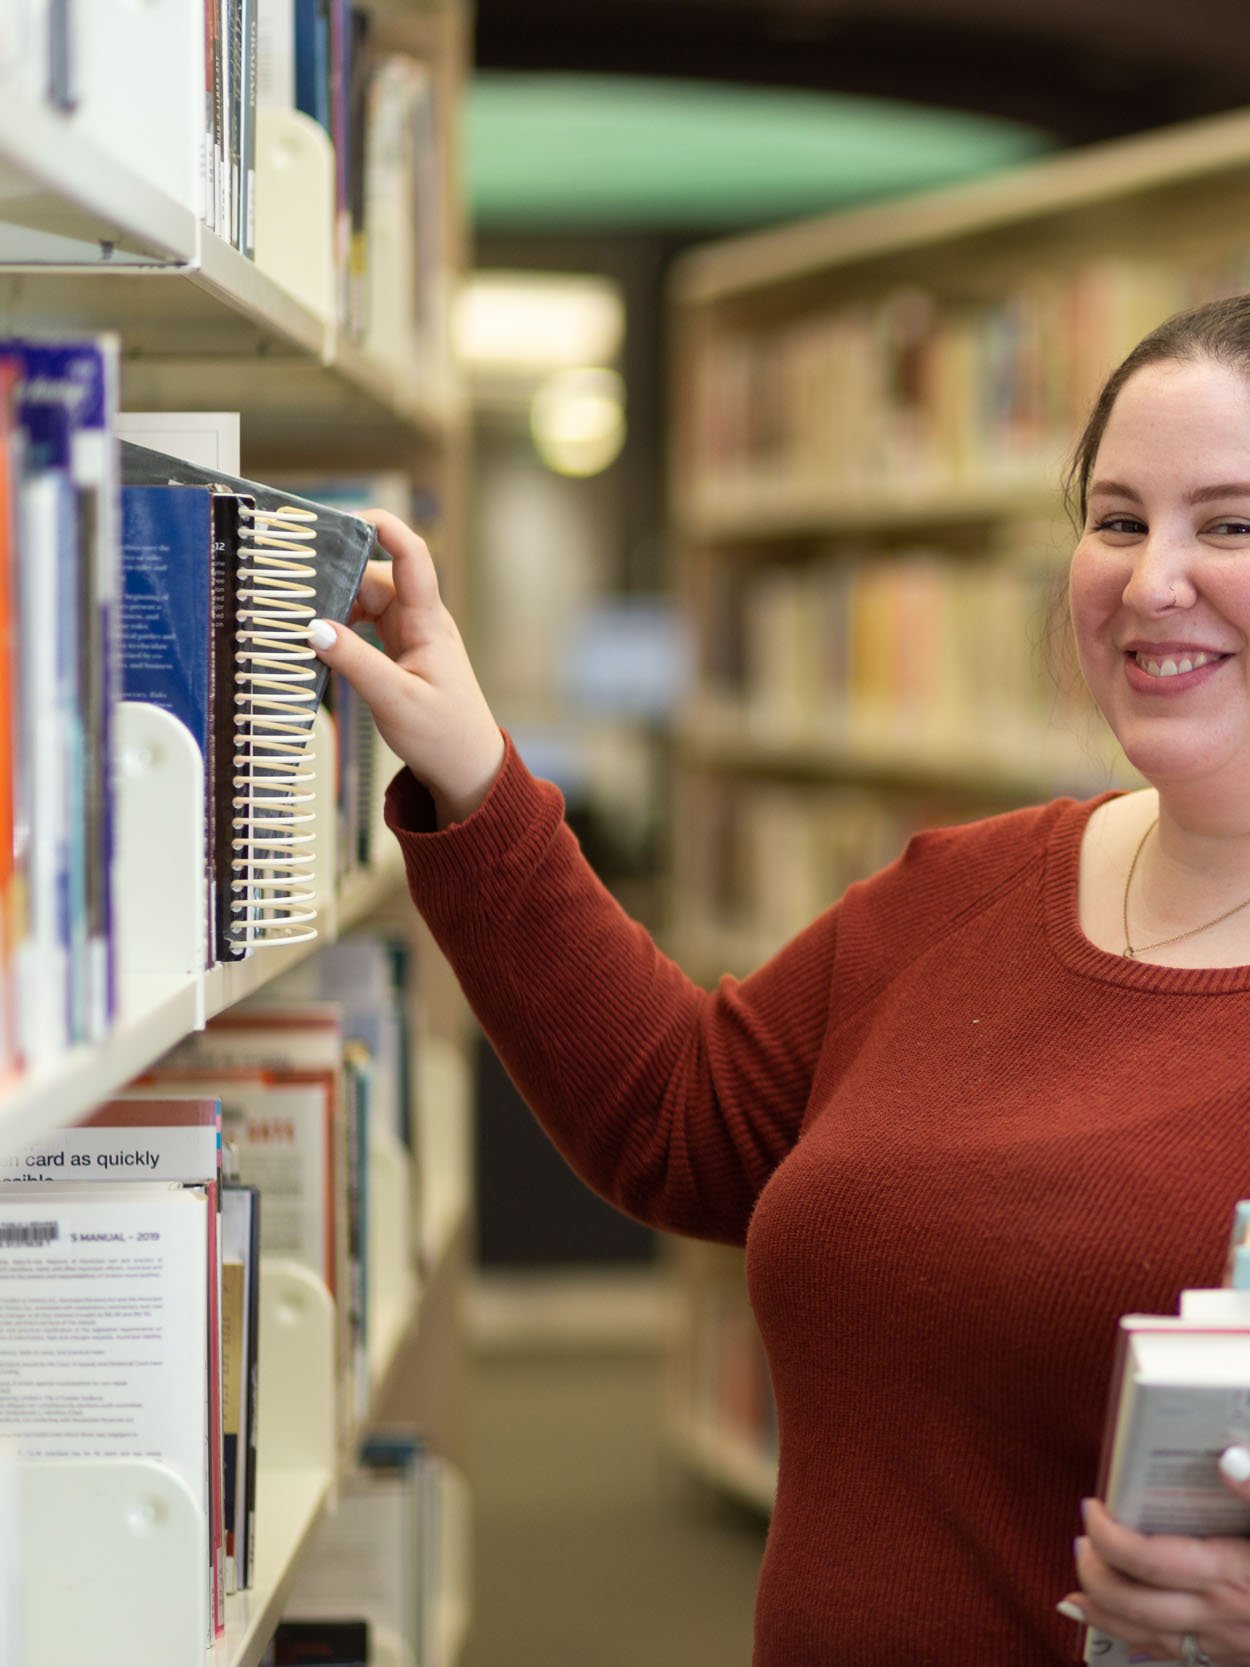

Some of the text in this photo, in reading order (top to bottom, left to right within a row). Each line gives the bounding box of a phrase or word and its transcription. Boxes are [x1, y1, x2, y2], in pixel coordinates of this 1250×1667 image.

[25, 1152, 65, 1167] card
[70, 1154, 91, 1167] as
[96, 1151, 160, 1170] quickly
[80, 1233, 125, 1242] MANUAL
